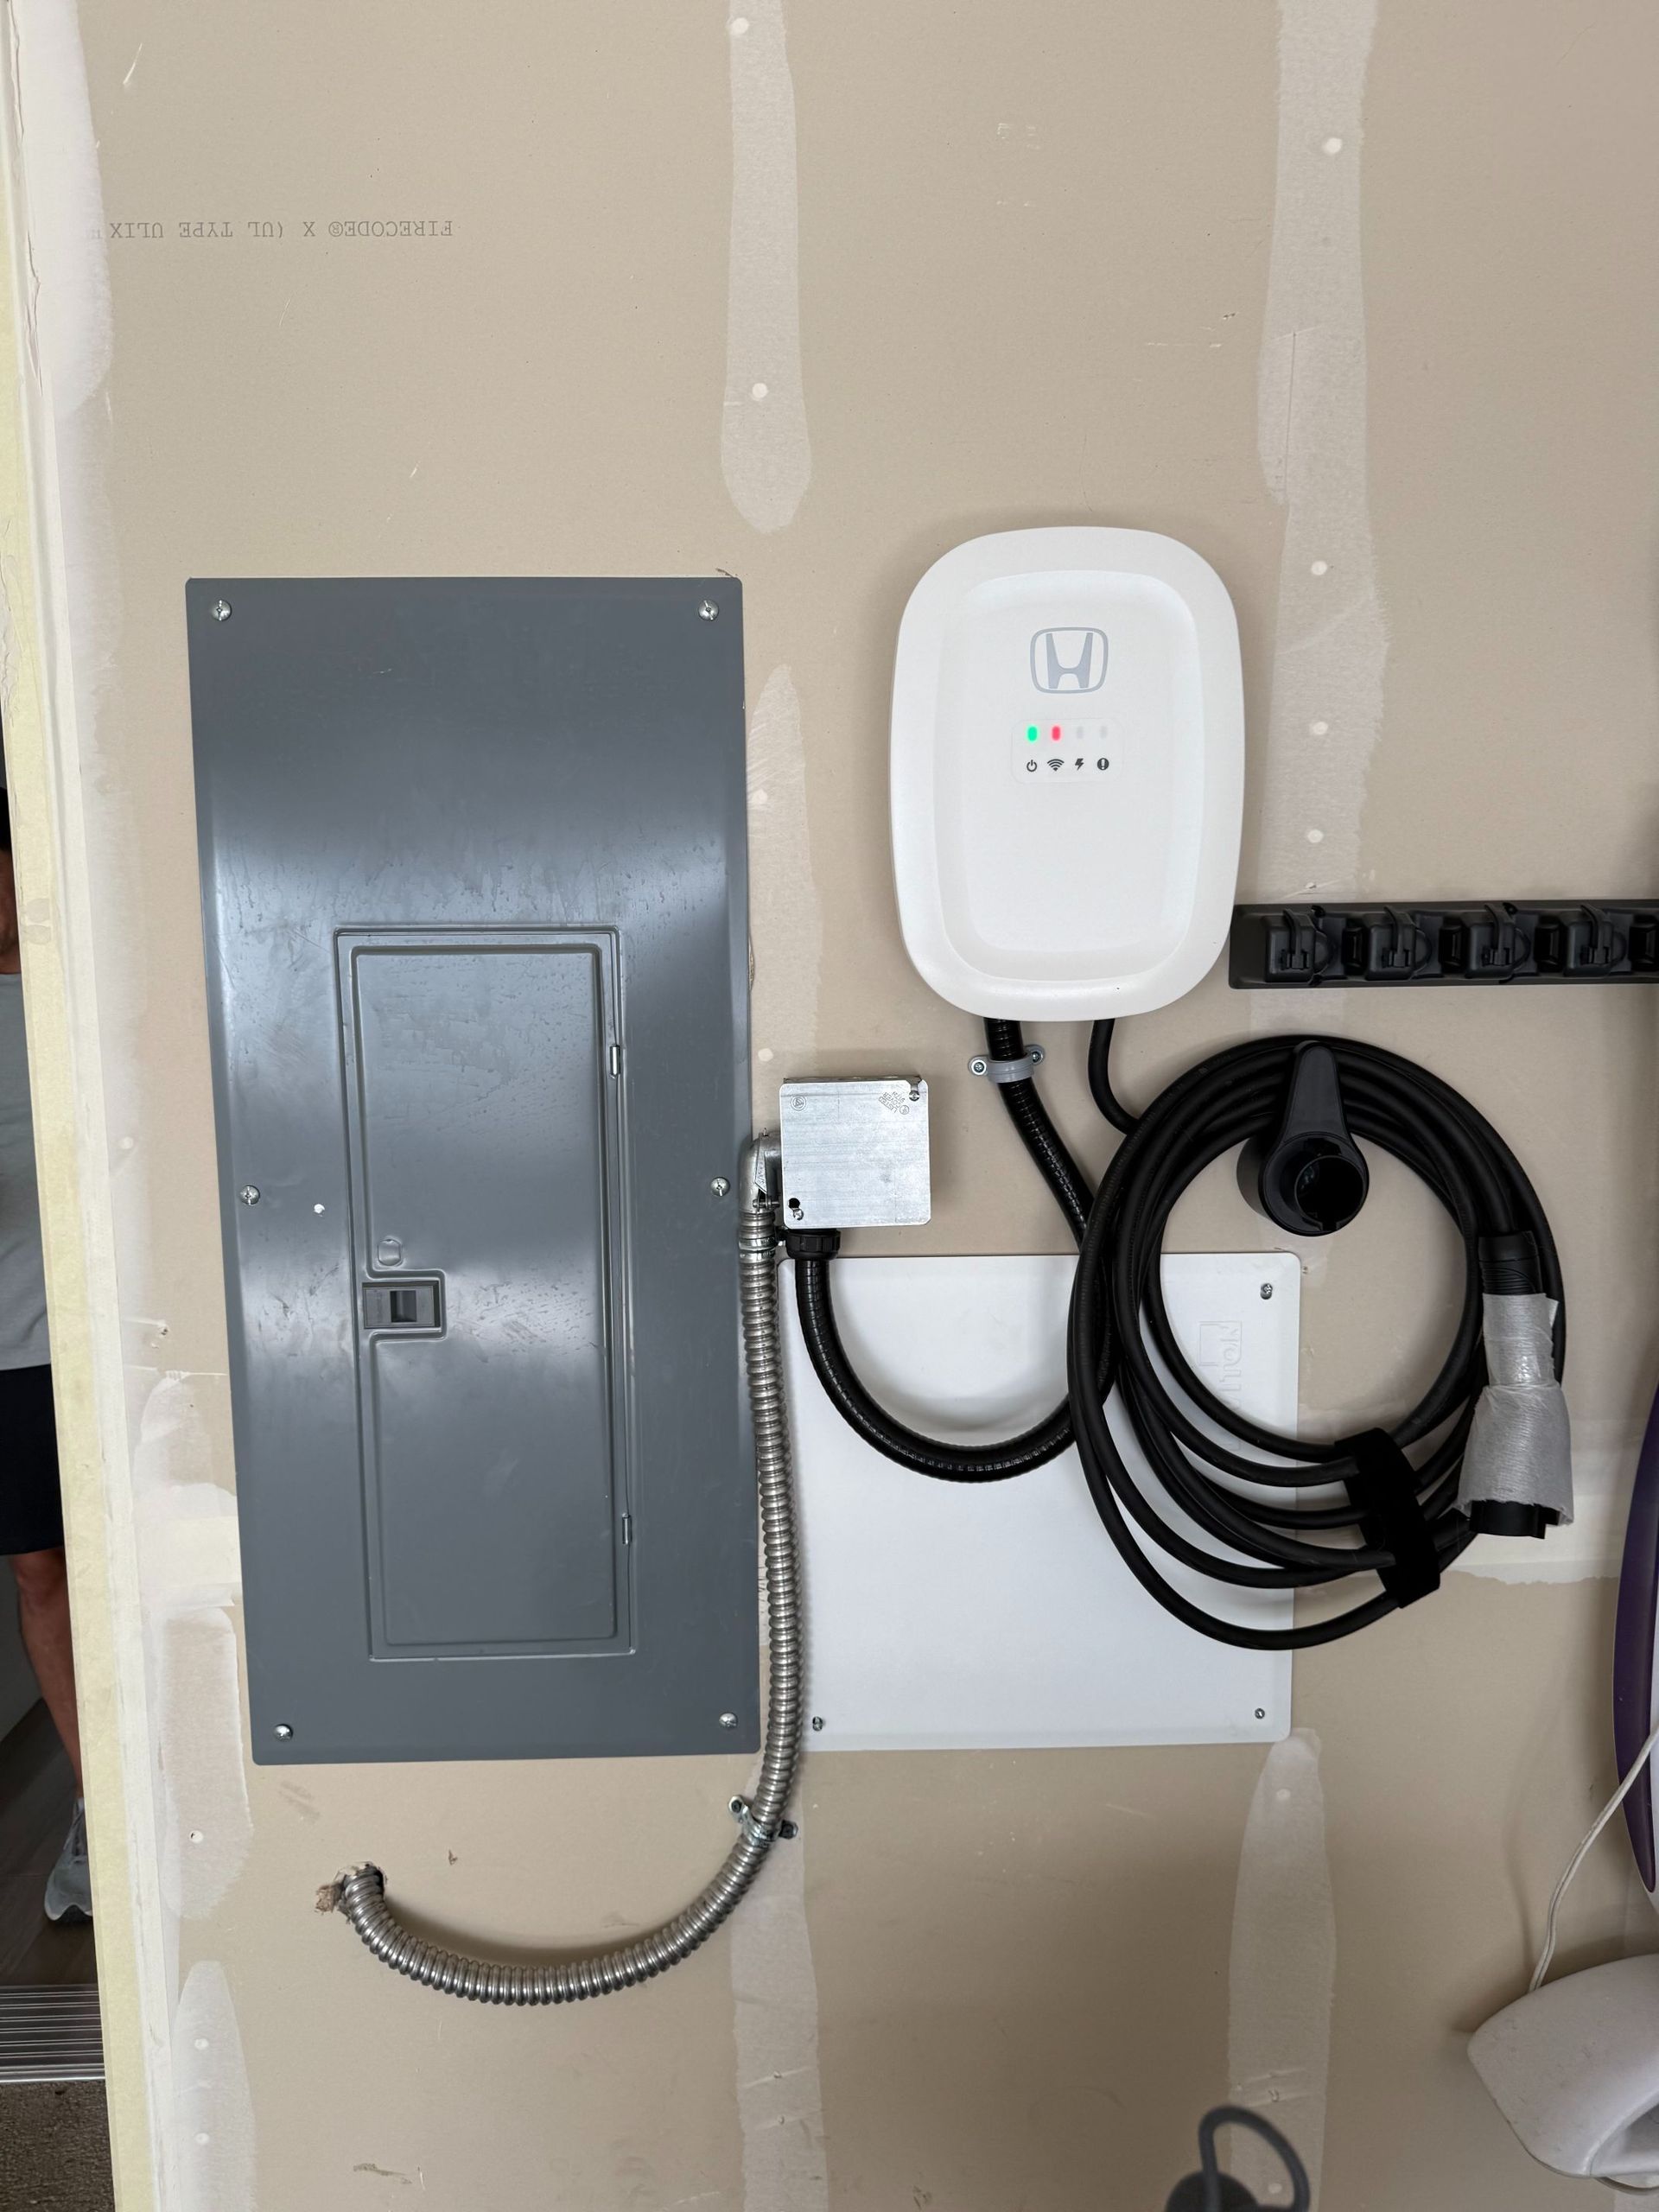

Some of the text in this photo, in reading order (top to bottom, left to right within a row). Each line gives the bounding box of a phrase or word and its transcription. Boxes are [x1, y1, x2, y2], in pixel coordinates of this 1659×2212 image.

[178, 221, 233, 238] TYPE
[247, 220, 283, 238] (UL
[302, 221, 316, 238] X
[327, 220, 454, 238] FIRECODE®
